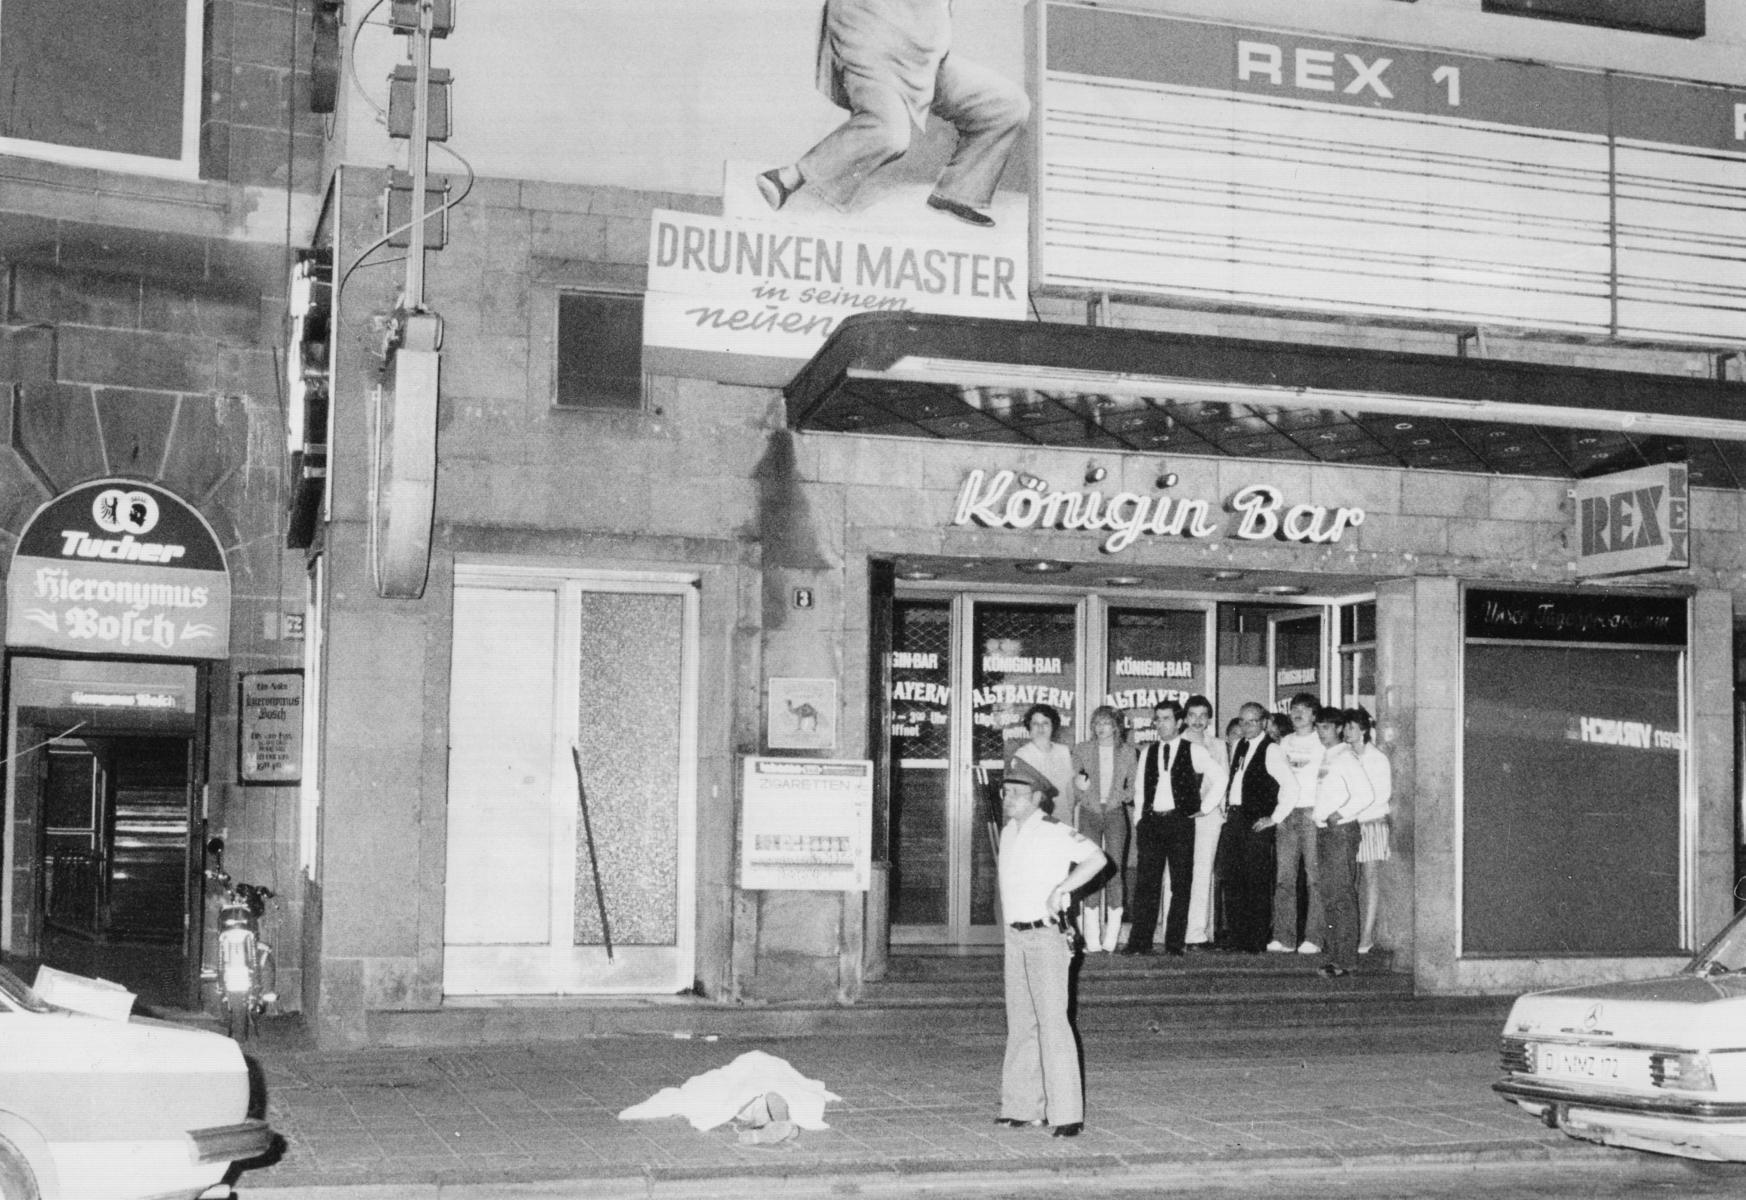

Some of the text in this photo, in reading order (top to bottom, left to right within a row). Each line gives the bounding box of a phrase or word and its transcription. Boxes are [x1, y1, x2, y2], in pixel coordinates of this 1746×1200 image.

[1238, 40, 1461, 106] REX 1
[656, 221, 1017, 301] DRUNKEN MASTER
[752, 281, 914, 313] in seinem
[685, 305, 833, 338] neuen
[954, 467, 1365, 553] Königin Bar
[1581, 484, 1665, 557] REX
[62, 530, 185, 562] Tucher
[34, 567, 209, 611] Hieronymus
[1116, 656, 1192, 678] KÖNIGIN-BAR
[892, 681, 952, 706] AYERN
[972, 684, 1074, 710] ALTBAYERN
[1107, 688, 1190, 709] ALTBAYER
[759, 778, 851, 792] ZIGARETTEN
